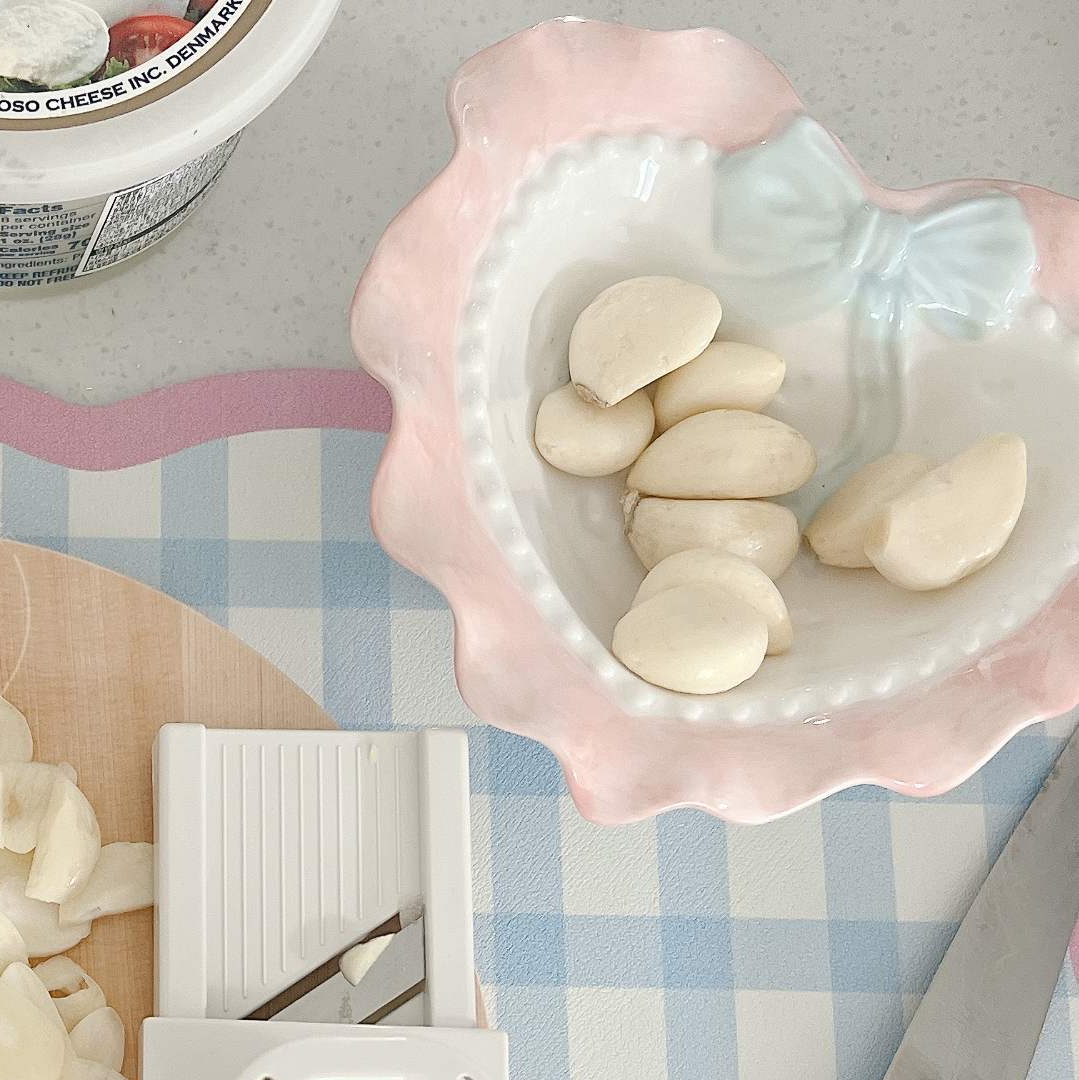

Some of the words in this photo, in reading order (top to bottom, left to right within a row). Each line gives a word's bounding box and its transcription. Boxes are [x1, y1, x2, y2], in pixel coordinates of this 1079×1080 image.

[46, 82, 127, 112] CHEESE
[128, 66, 167, 91] INC.
[165, 0, 243, 69] DENMARK
[0, 204, 64, 215] Facts
[14, 211, 77, 223] servings
[28, 212, 96, 230] container
[0, 229, 57, 238] Serving
[61, 222, 90, 232] size
[39, 231, 77, 244] (28g)
[0, 244, 59, 253] Calories
[17, 278, 43, 287] NOT
